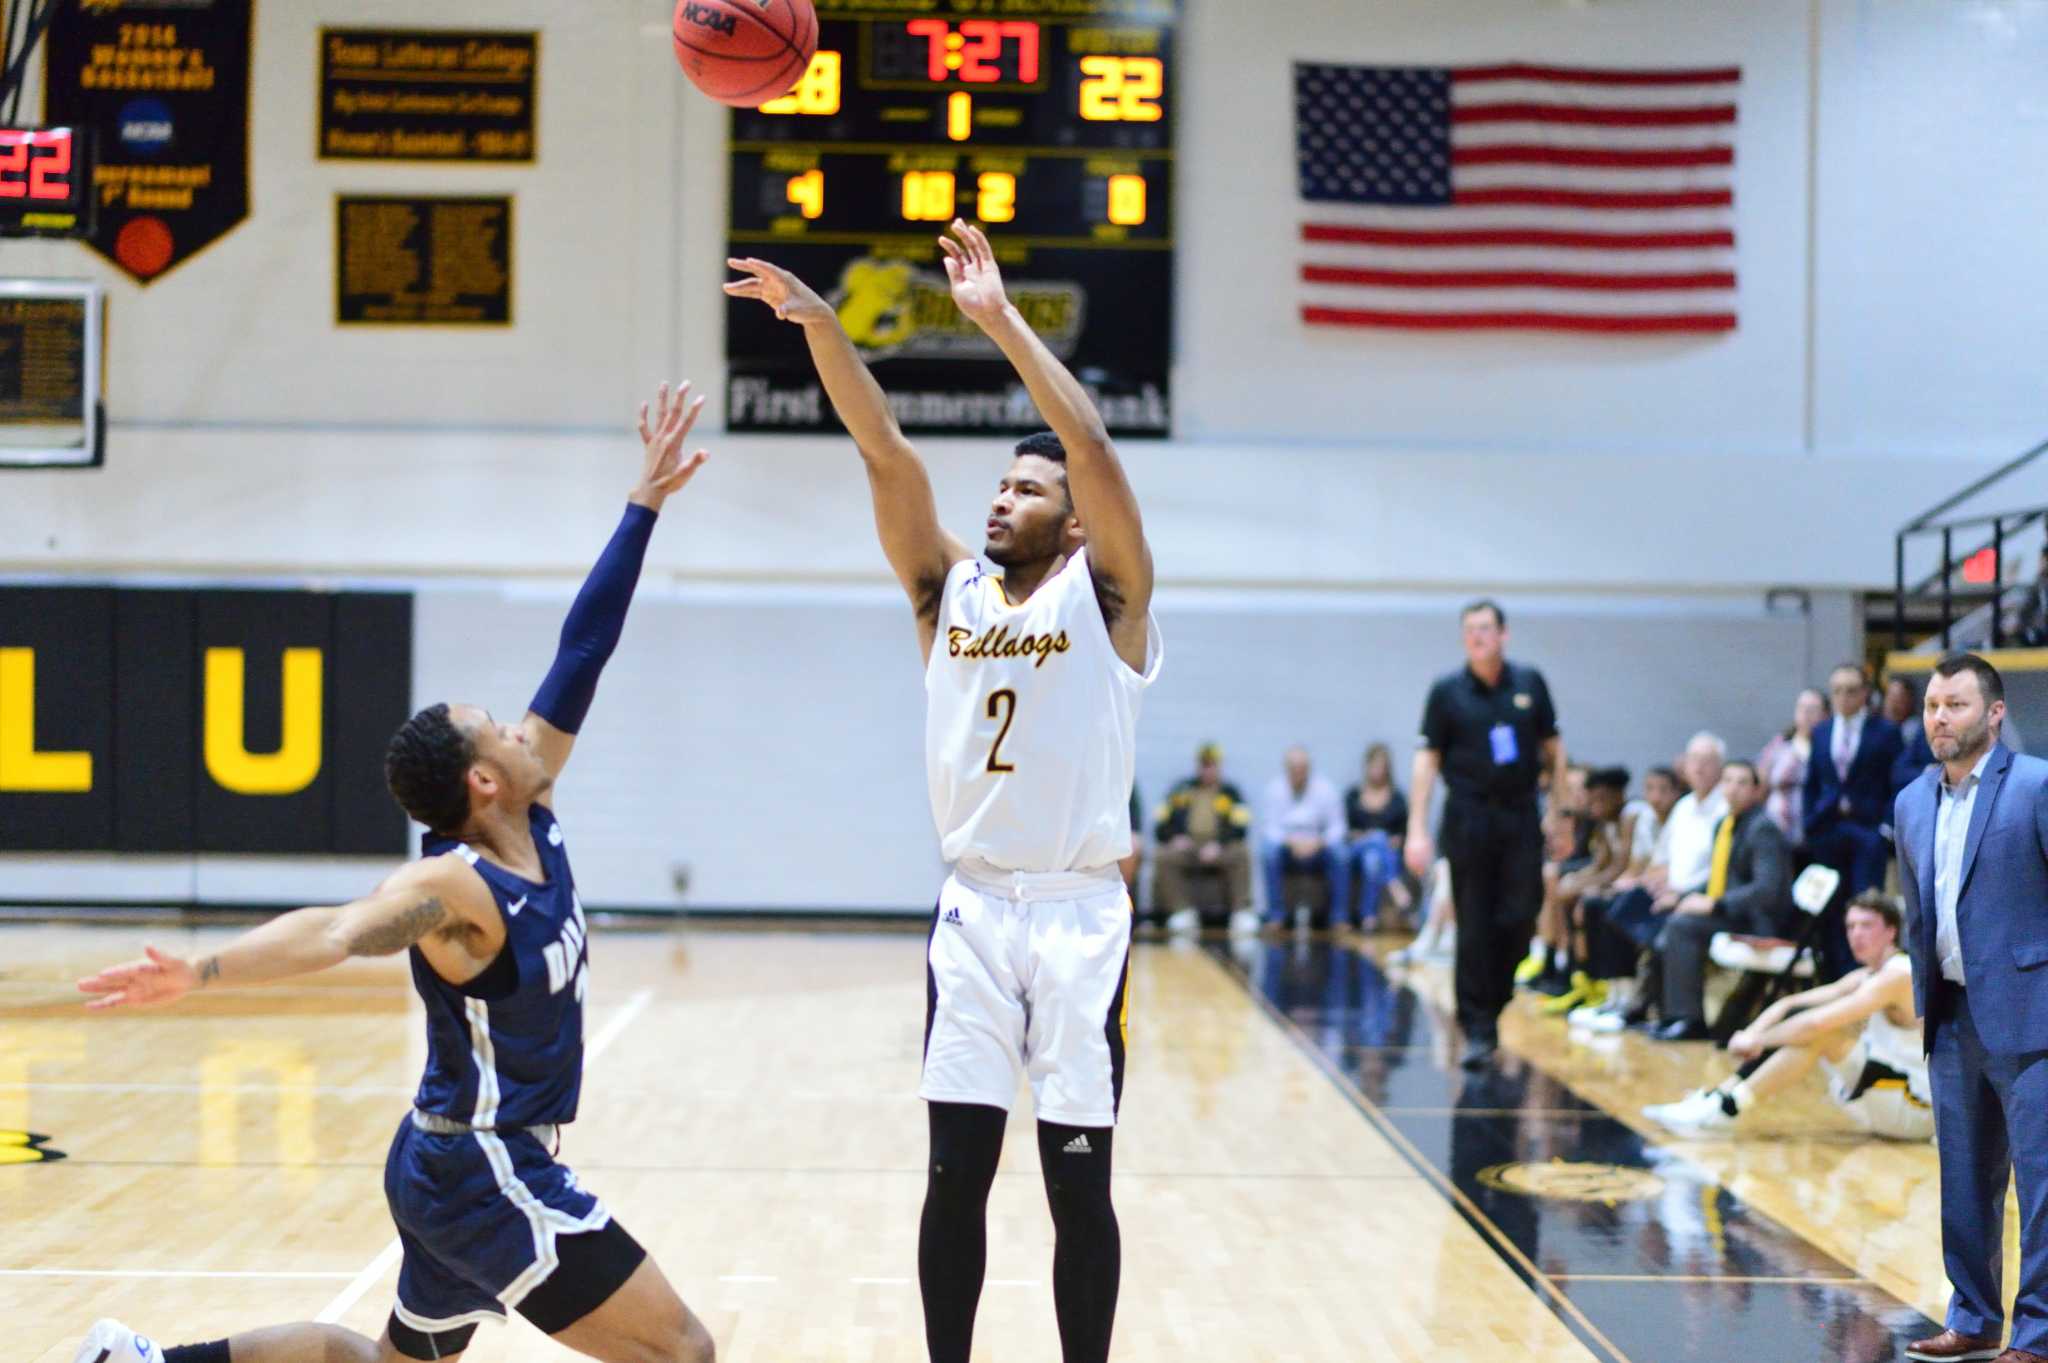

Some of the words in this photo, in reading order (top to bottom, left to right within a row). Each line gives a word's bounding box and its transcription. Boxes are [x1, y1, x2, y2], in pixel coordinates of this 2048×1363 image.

[684, 0, 736, 37] NCAA
[906, 19, 1040, 83] 7:27
[1079, 55, 1163, 122] 22
[0, 127, 72, 200] 22
[986, 687, 1018, 773] 2
